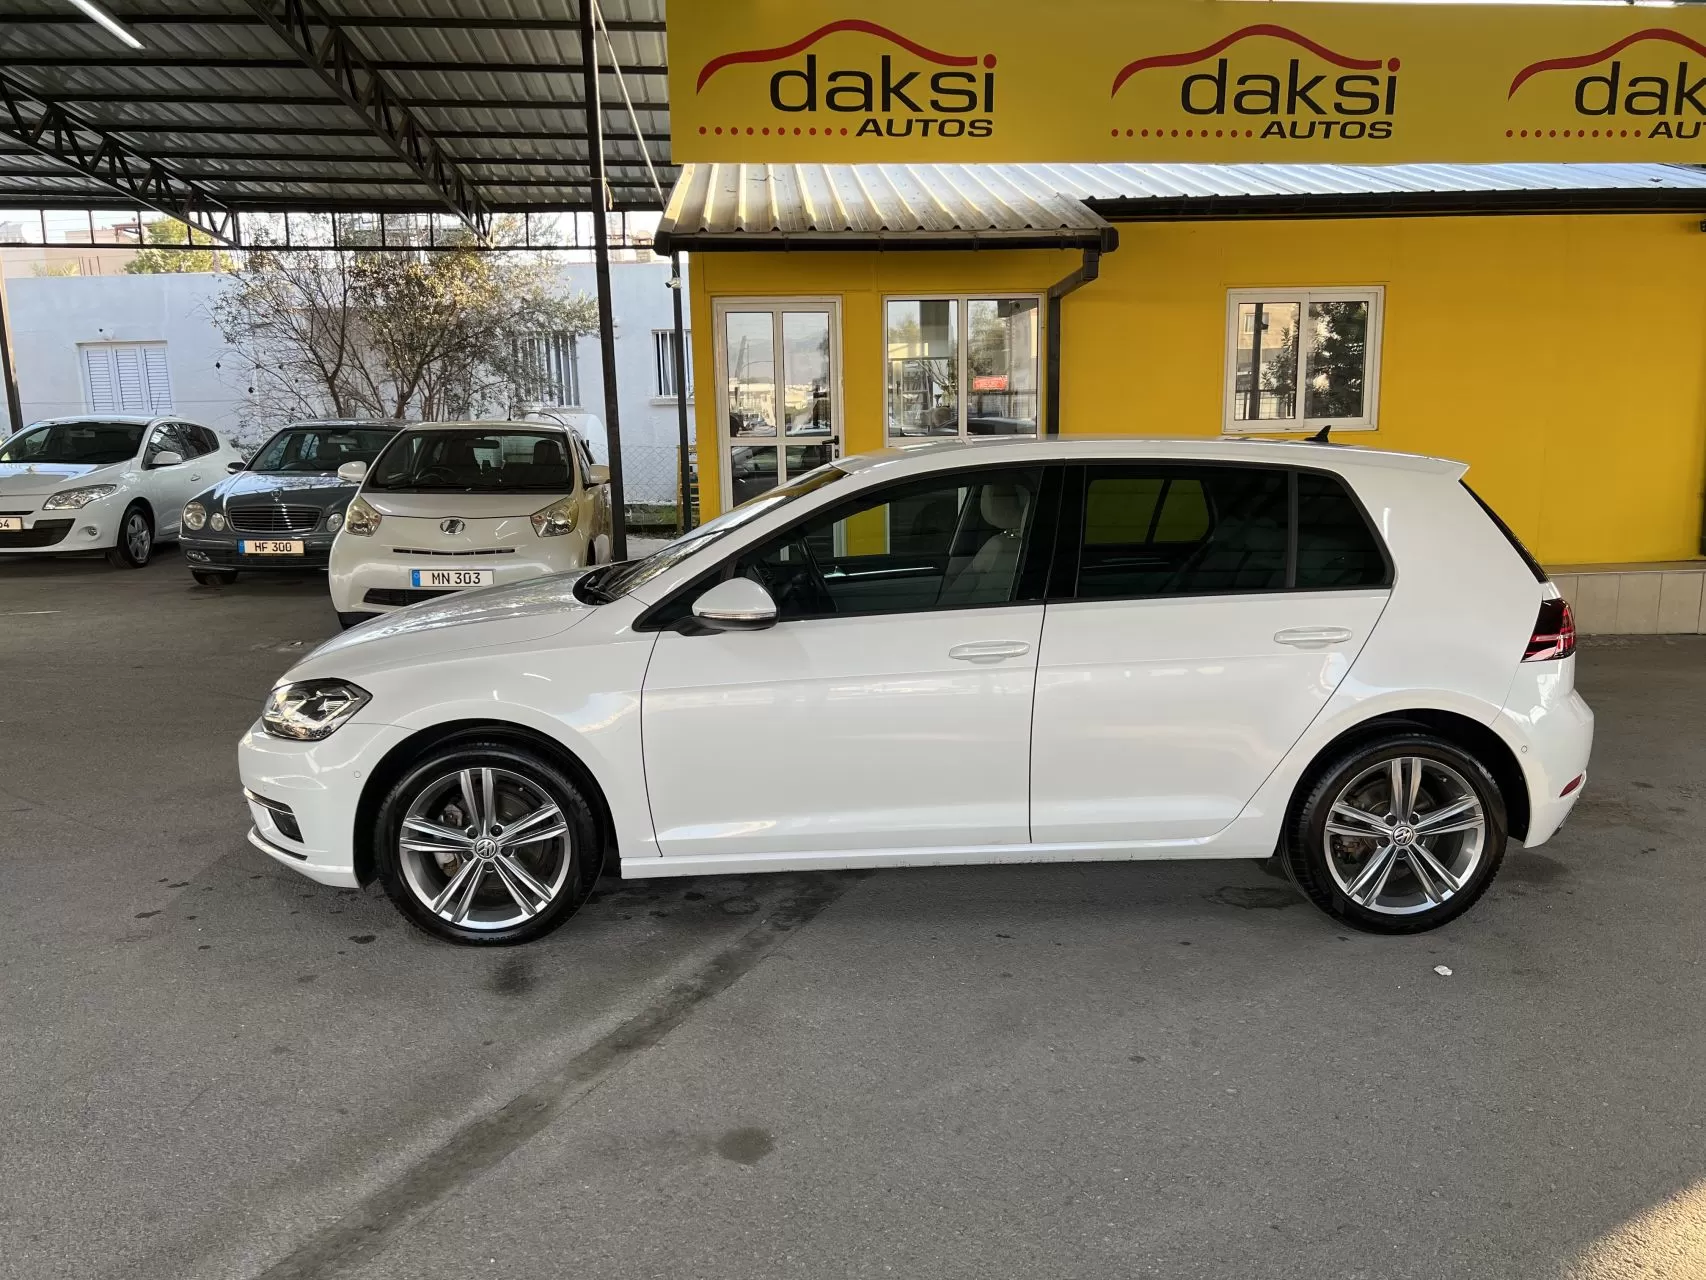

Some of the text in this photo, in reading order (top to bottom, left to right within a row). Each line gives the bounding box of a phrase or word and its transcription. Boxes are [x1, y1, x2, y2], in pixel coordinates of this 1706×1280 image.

[769, 53, 997, 113] daksi
[1181, 57, 1401, 116] daksi
[855, 118, 993, 138] AUTOS
[1259, 120, 1393, 139] AUTOS
[1647, 121, 1706, 139] AU
[254, 541, 292, 552] HF 300
[431, 572, 481, 585] MN 303
